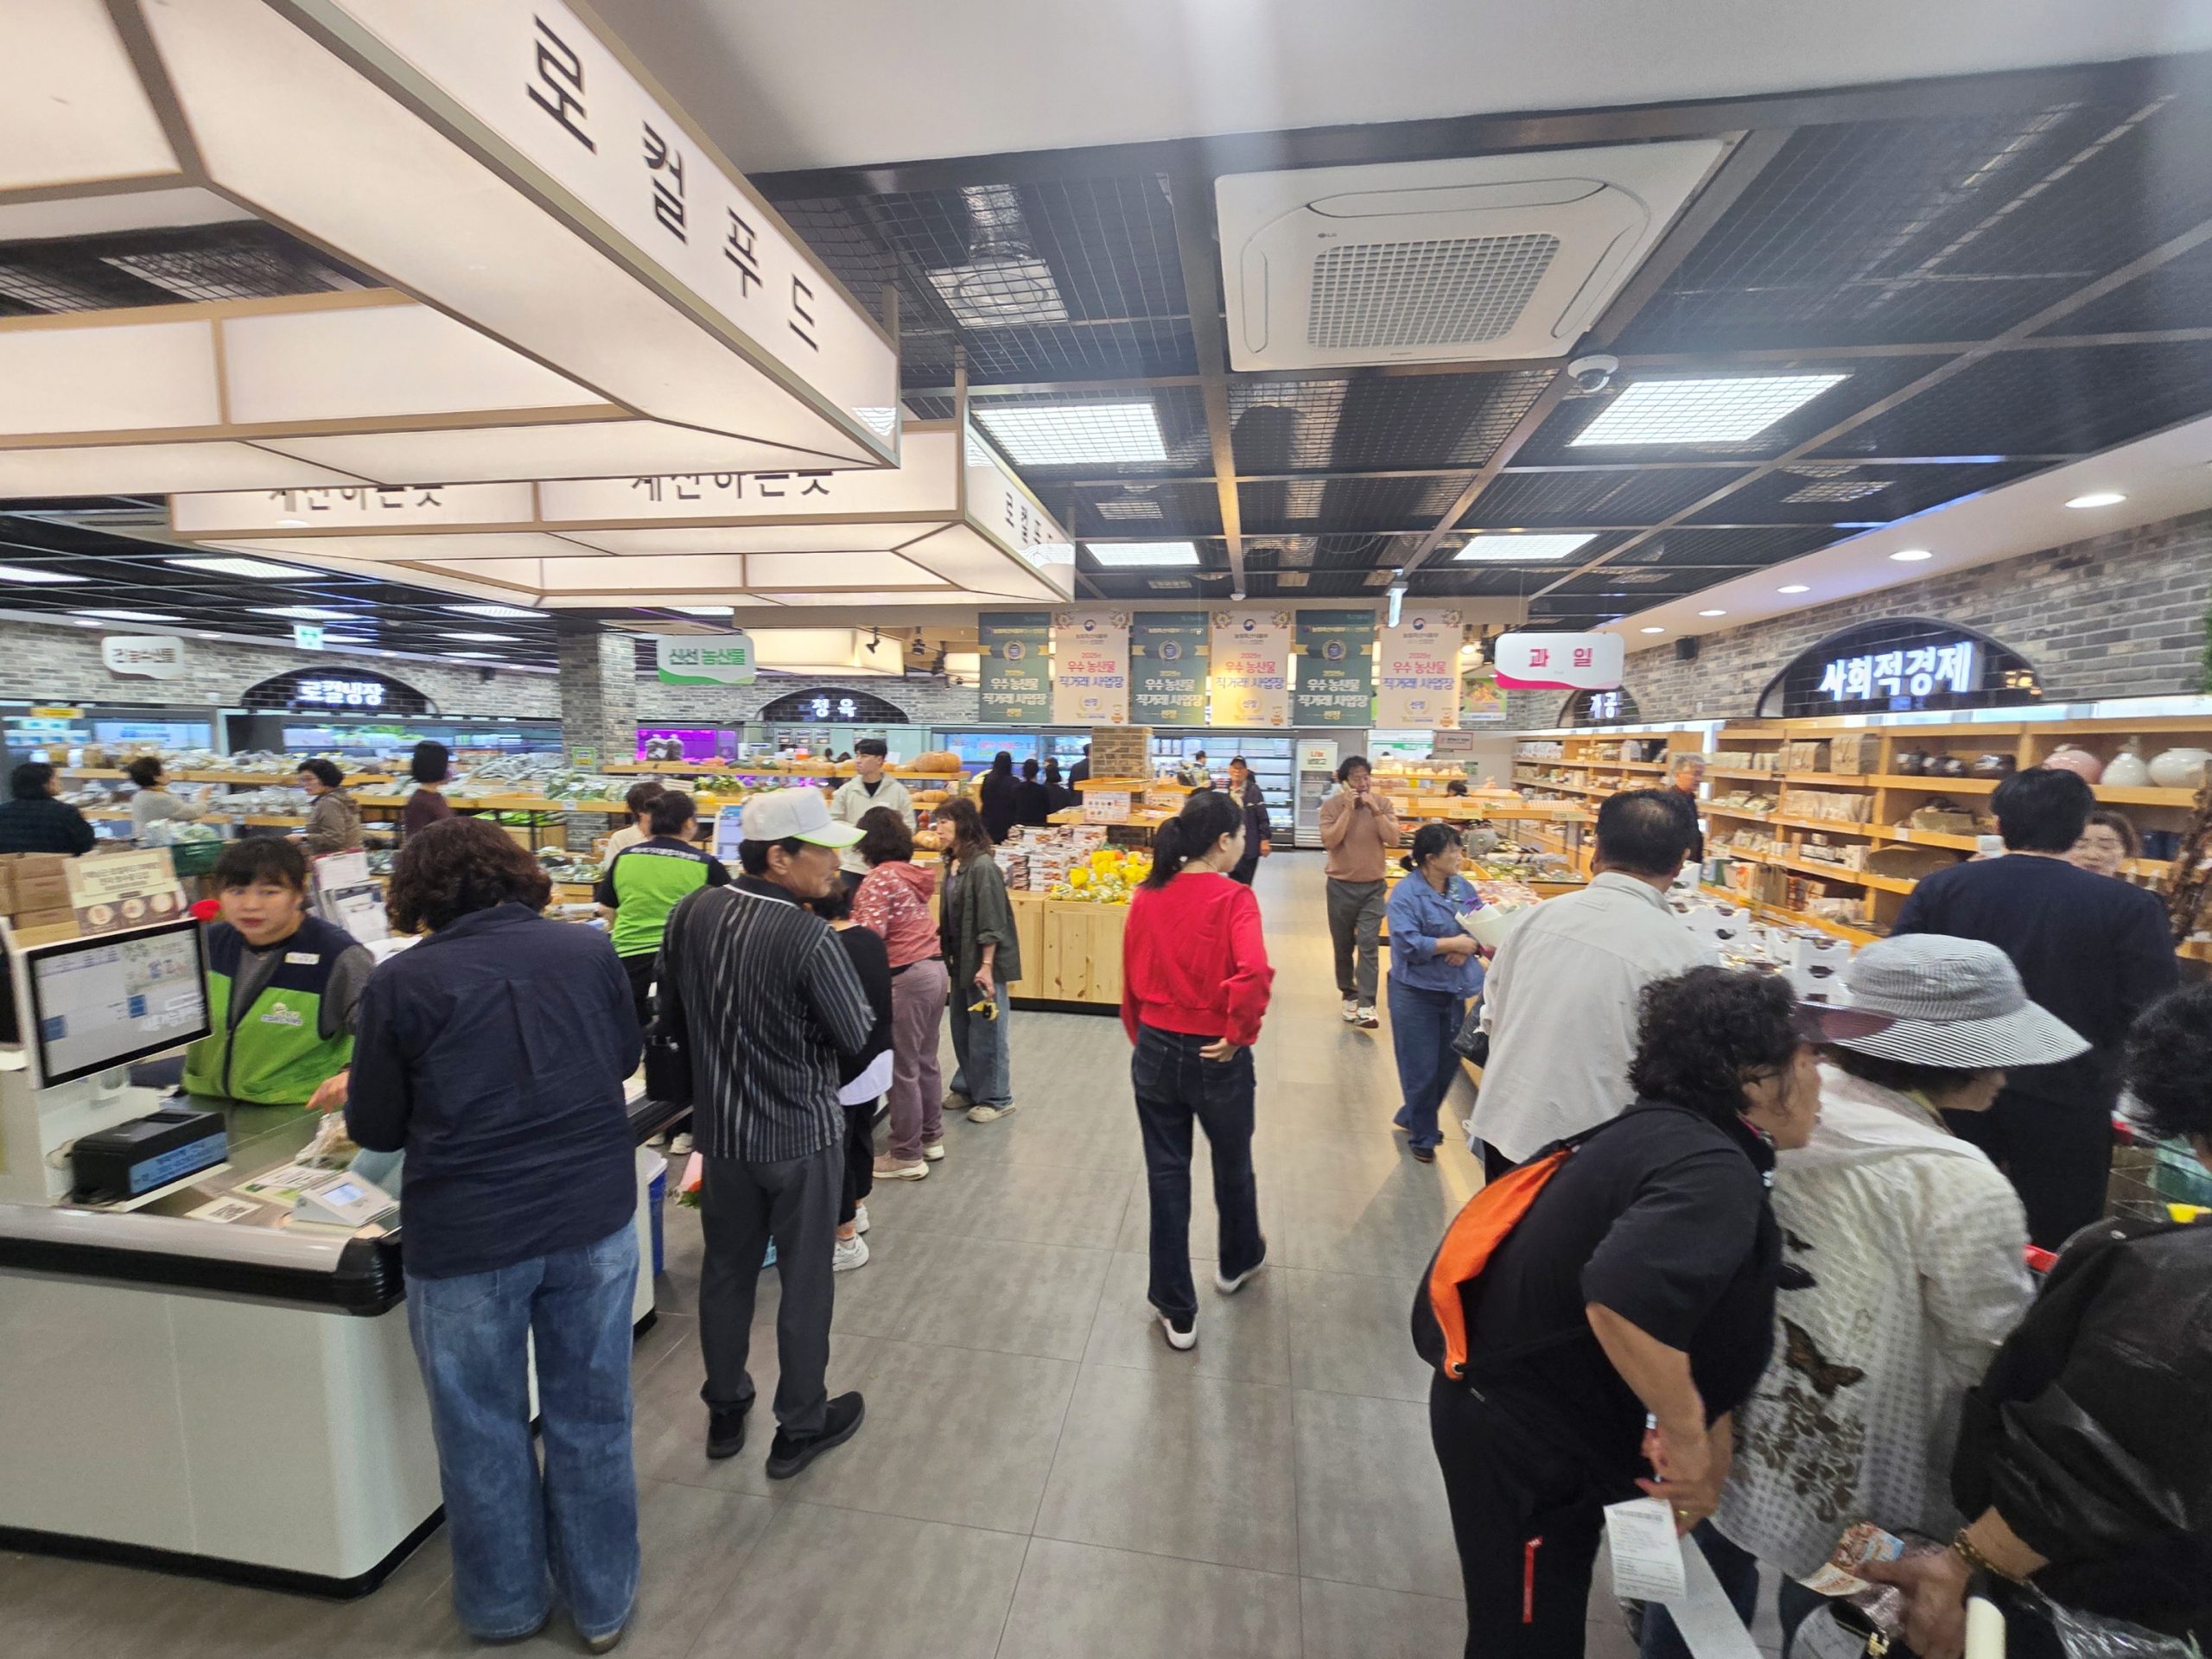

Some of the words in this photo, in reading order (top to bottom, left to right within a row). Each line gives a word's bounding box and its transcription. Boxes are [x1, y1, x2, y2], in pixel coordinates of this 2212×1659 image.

[526, 13, 818, 353] 로컬푸드
[669, 648, 698, 664] 신선
[702, 648, 746, 664] 농산물
[1067, 661, 1085, 673] 우수
[1086, 660, 1116, 673] 농산물
[1225, 661, 1245, 675] 우수
[1246, 660, 1275, 674] 농산물
[1393, 661, 1413, 674] 우수
[1414, 661, 1446, 674] 농산물
[1819, 641, 1973, 701] 사회적경제
[990, 677, 1009, 690] 우수
[1010, 677, 1039, 690] 농산물
[1058, 676, 1090, 688] 직거래
[1091, 676, 1124, 688] 사업장
[1144, 678, 1164, 690] 우수
[1165, 678, 1195, 691] 농산물
[1216, 677, 1250, 690] 직거래
[1252, 677, 1285, 690] 사업장
[1307, 678, 1328, 691] 우수
[1328, 678, 1360, 692] 농산물
[1382, 677, 1417, 690] 직거래
[1419, 677, 1455, 690] 사업장
[296, 679, 386, 705] 로컬냉장
[982, 693, 1014, 705] 직거래
[1016, 693, 1047, 706] 사업장
[1135, 694, 1169, 707] 직거래
[1170, 694, 1204, 707] 사업장
[1298, 695, 1332, 708] 직거래
[1333, 695, 1369, 708] 사업장
